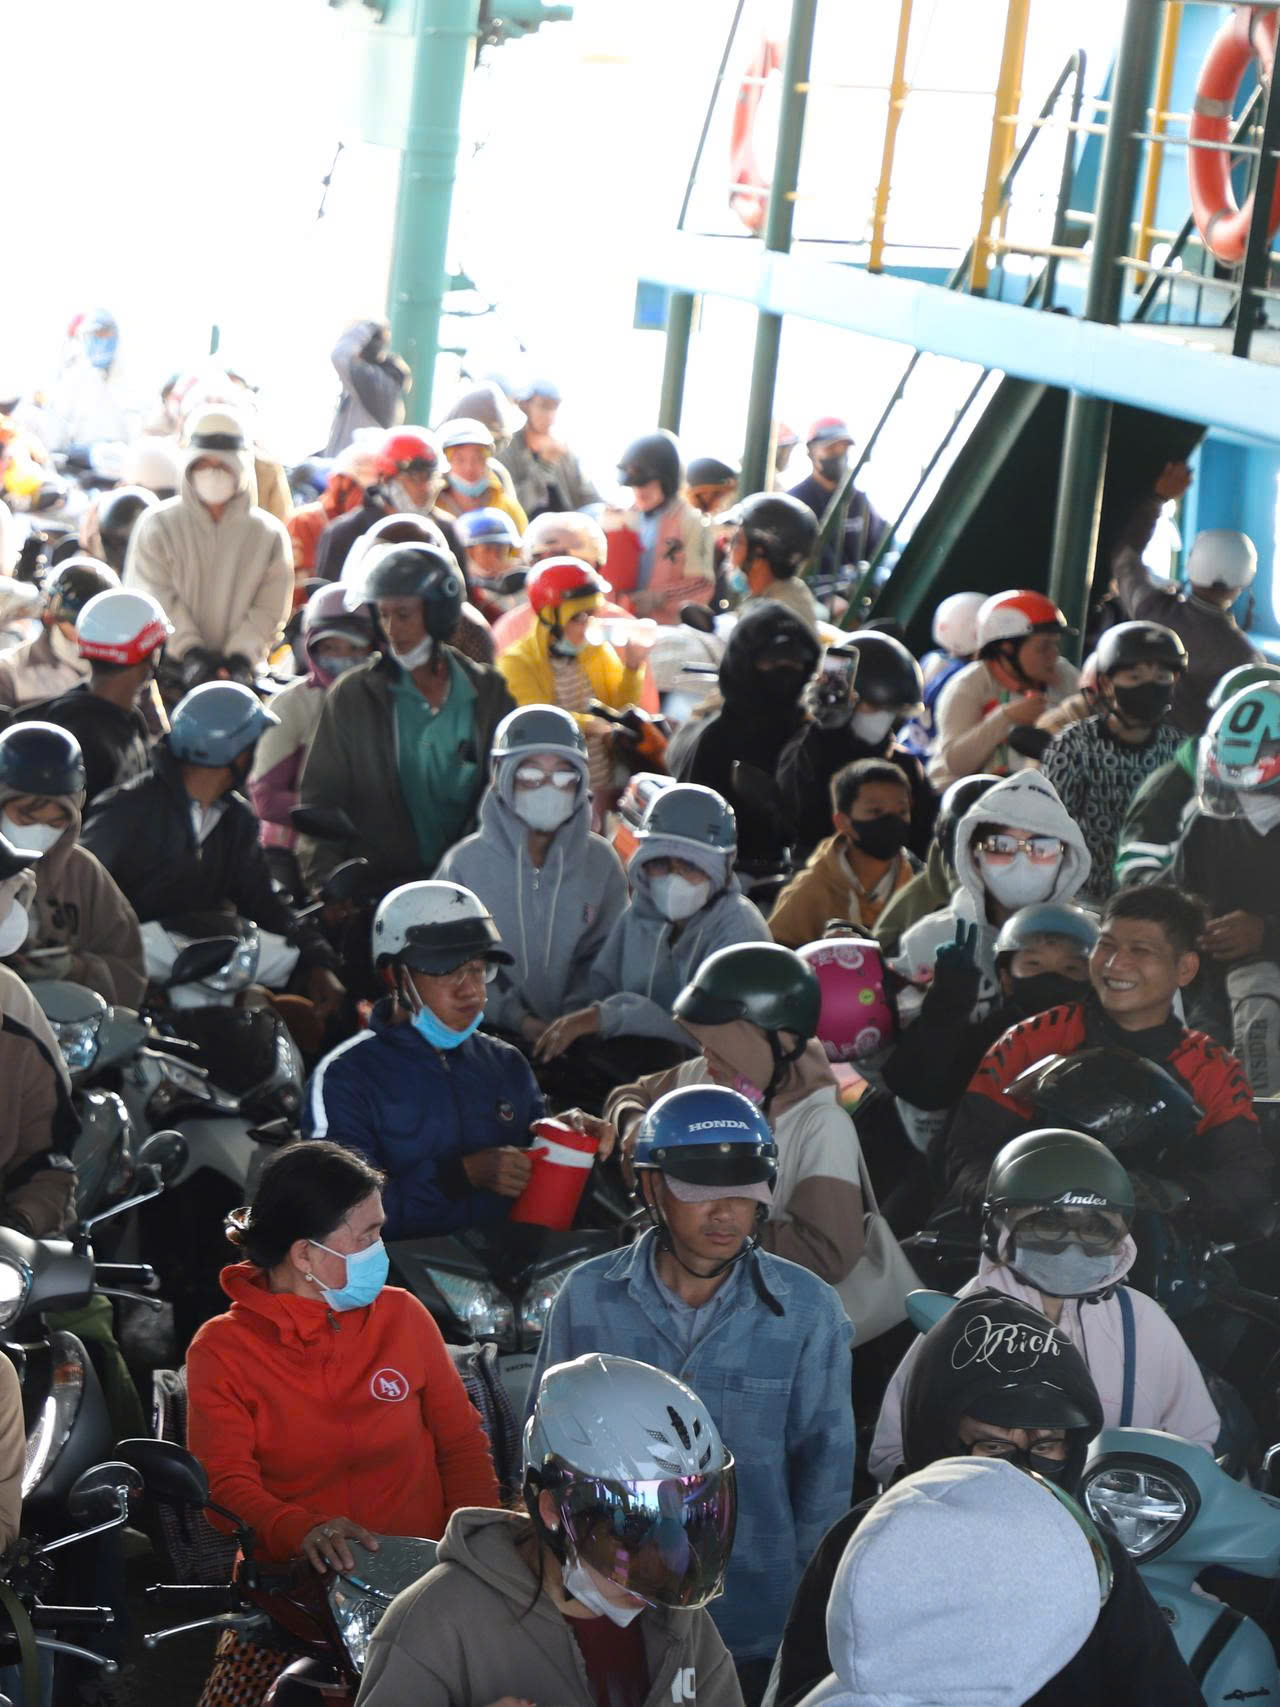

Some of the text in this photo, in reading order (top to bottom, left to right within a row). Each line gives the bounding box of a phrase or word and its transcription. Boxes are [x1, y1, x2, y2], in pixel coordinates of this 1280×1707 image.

[687, 1119, 751, 1133] HONDA
[1053, 1191, 1107, 1206] Andes
[952, 1316, 1061, 1371] Rich
